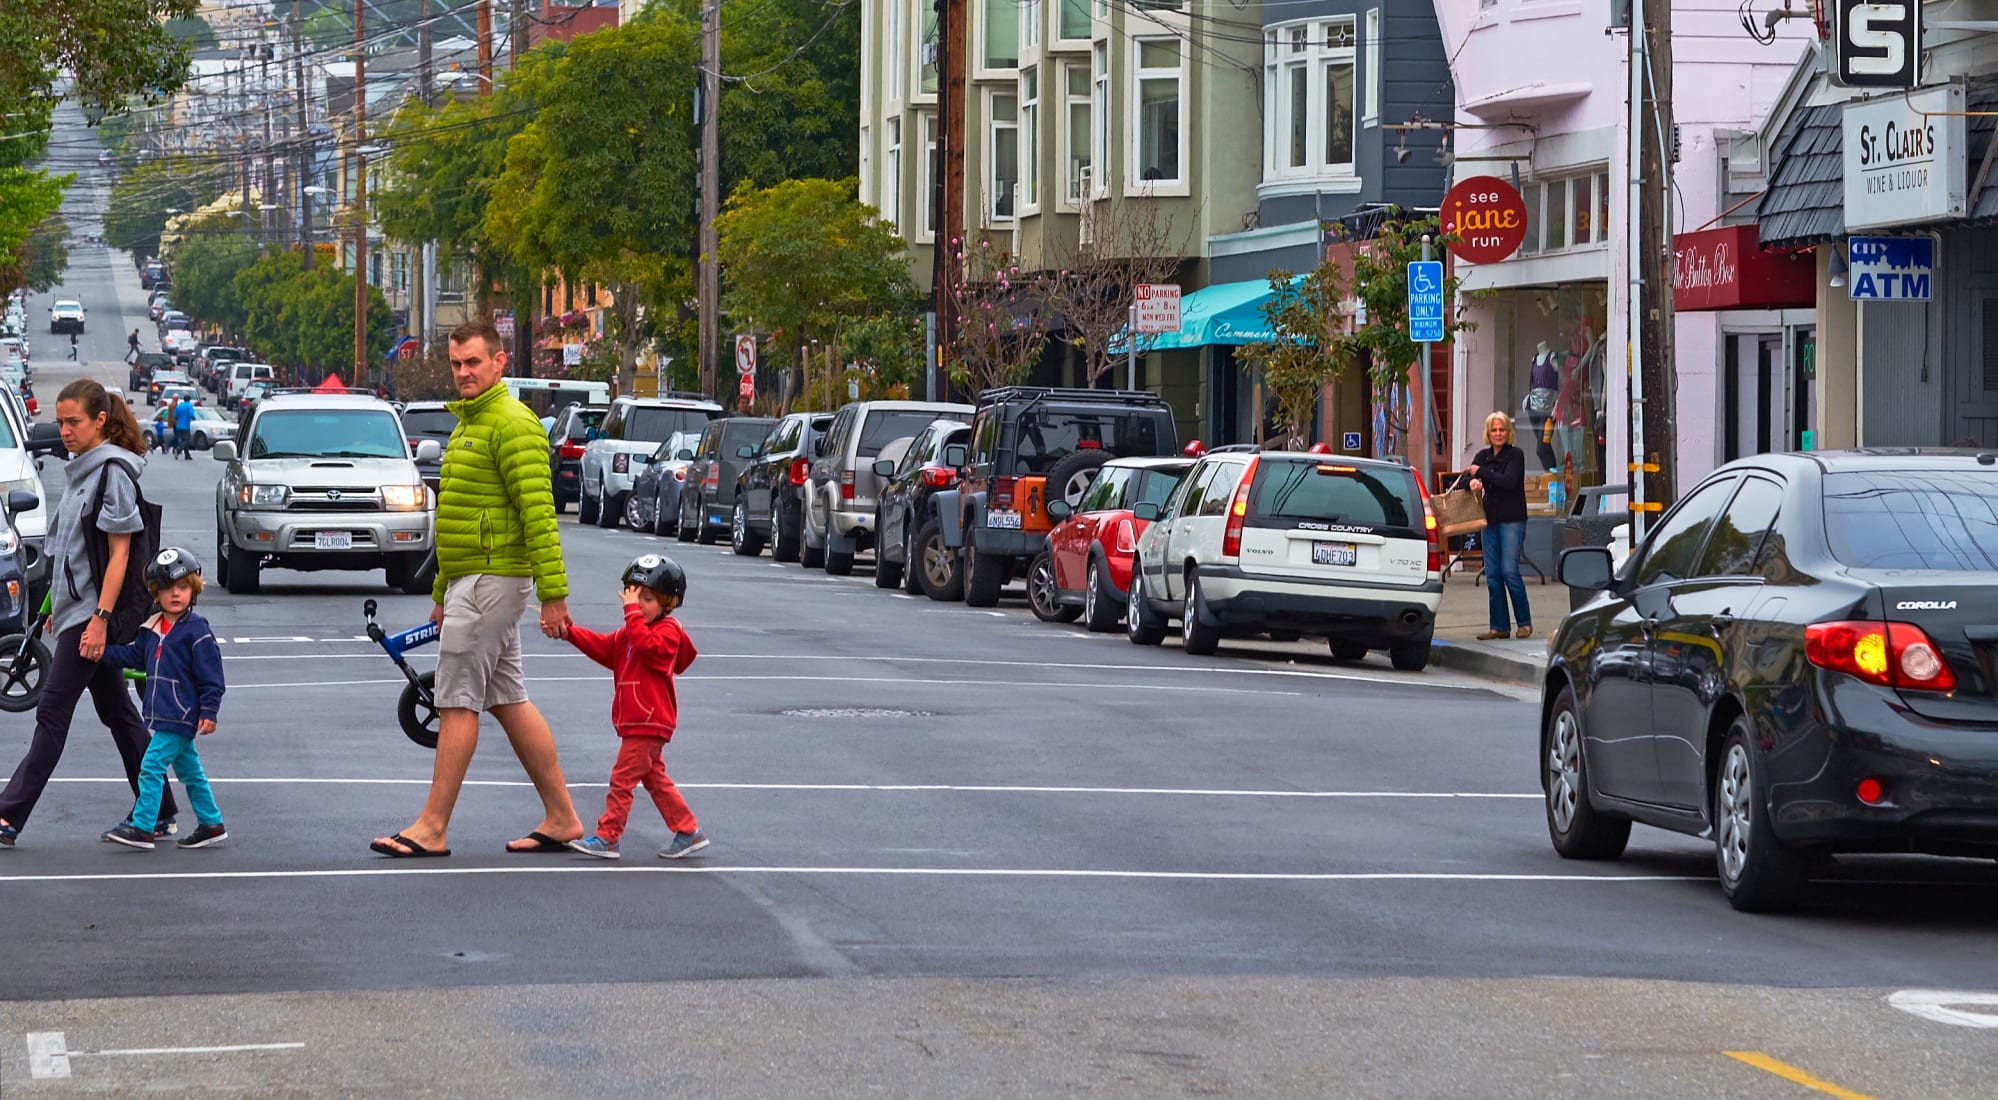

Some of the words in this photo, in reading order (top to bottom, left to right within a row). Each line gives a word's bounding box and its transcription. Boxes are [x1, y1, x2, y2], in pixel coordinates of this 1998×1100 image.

[1848, 3, 1906, 75] S
[1885, 114, 1934, 161] CLAIR'S
[1866, 175, 1886, 194] WINE
[1888, 173, 1894, 192] &
[1897, 169, 1928, 191] LIQUOR
[1470, 192, 1499, 204] see
[1454, 201, 1520, 237] jane
[1472, 236, 1500, 248] run
[1851, 242, 1889, 255] CITY
[1684, 246, 1712, 298] Button
[1713, 243, 1735, 285] Box
[1852, 272, 1930, 298] ATM
[1137, 286, 1150, 299] NO
[1151, 289, 1179, 299] PARKING
[1411, 292, 1440, 304] PARKING
[1142, 313, 1154, 321] MON
[1155, 313, 1166, 321] WED
[1166, 313, 1175, 321] FRI
[1415, 305, 1434, 317] ONLY
[1414, 320, 1437, 328] MINIMUM
[741, 383, 752, 395] STOP
[1298, 522, 1329, 531] CROSS
[1330, 524, 1374, 533] COUNTRY
[1896, 600, 1957, 610] COROLLA
